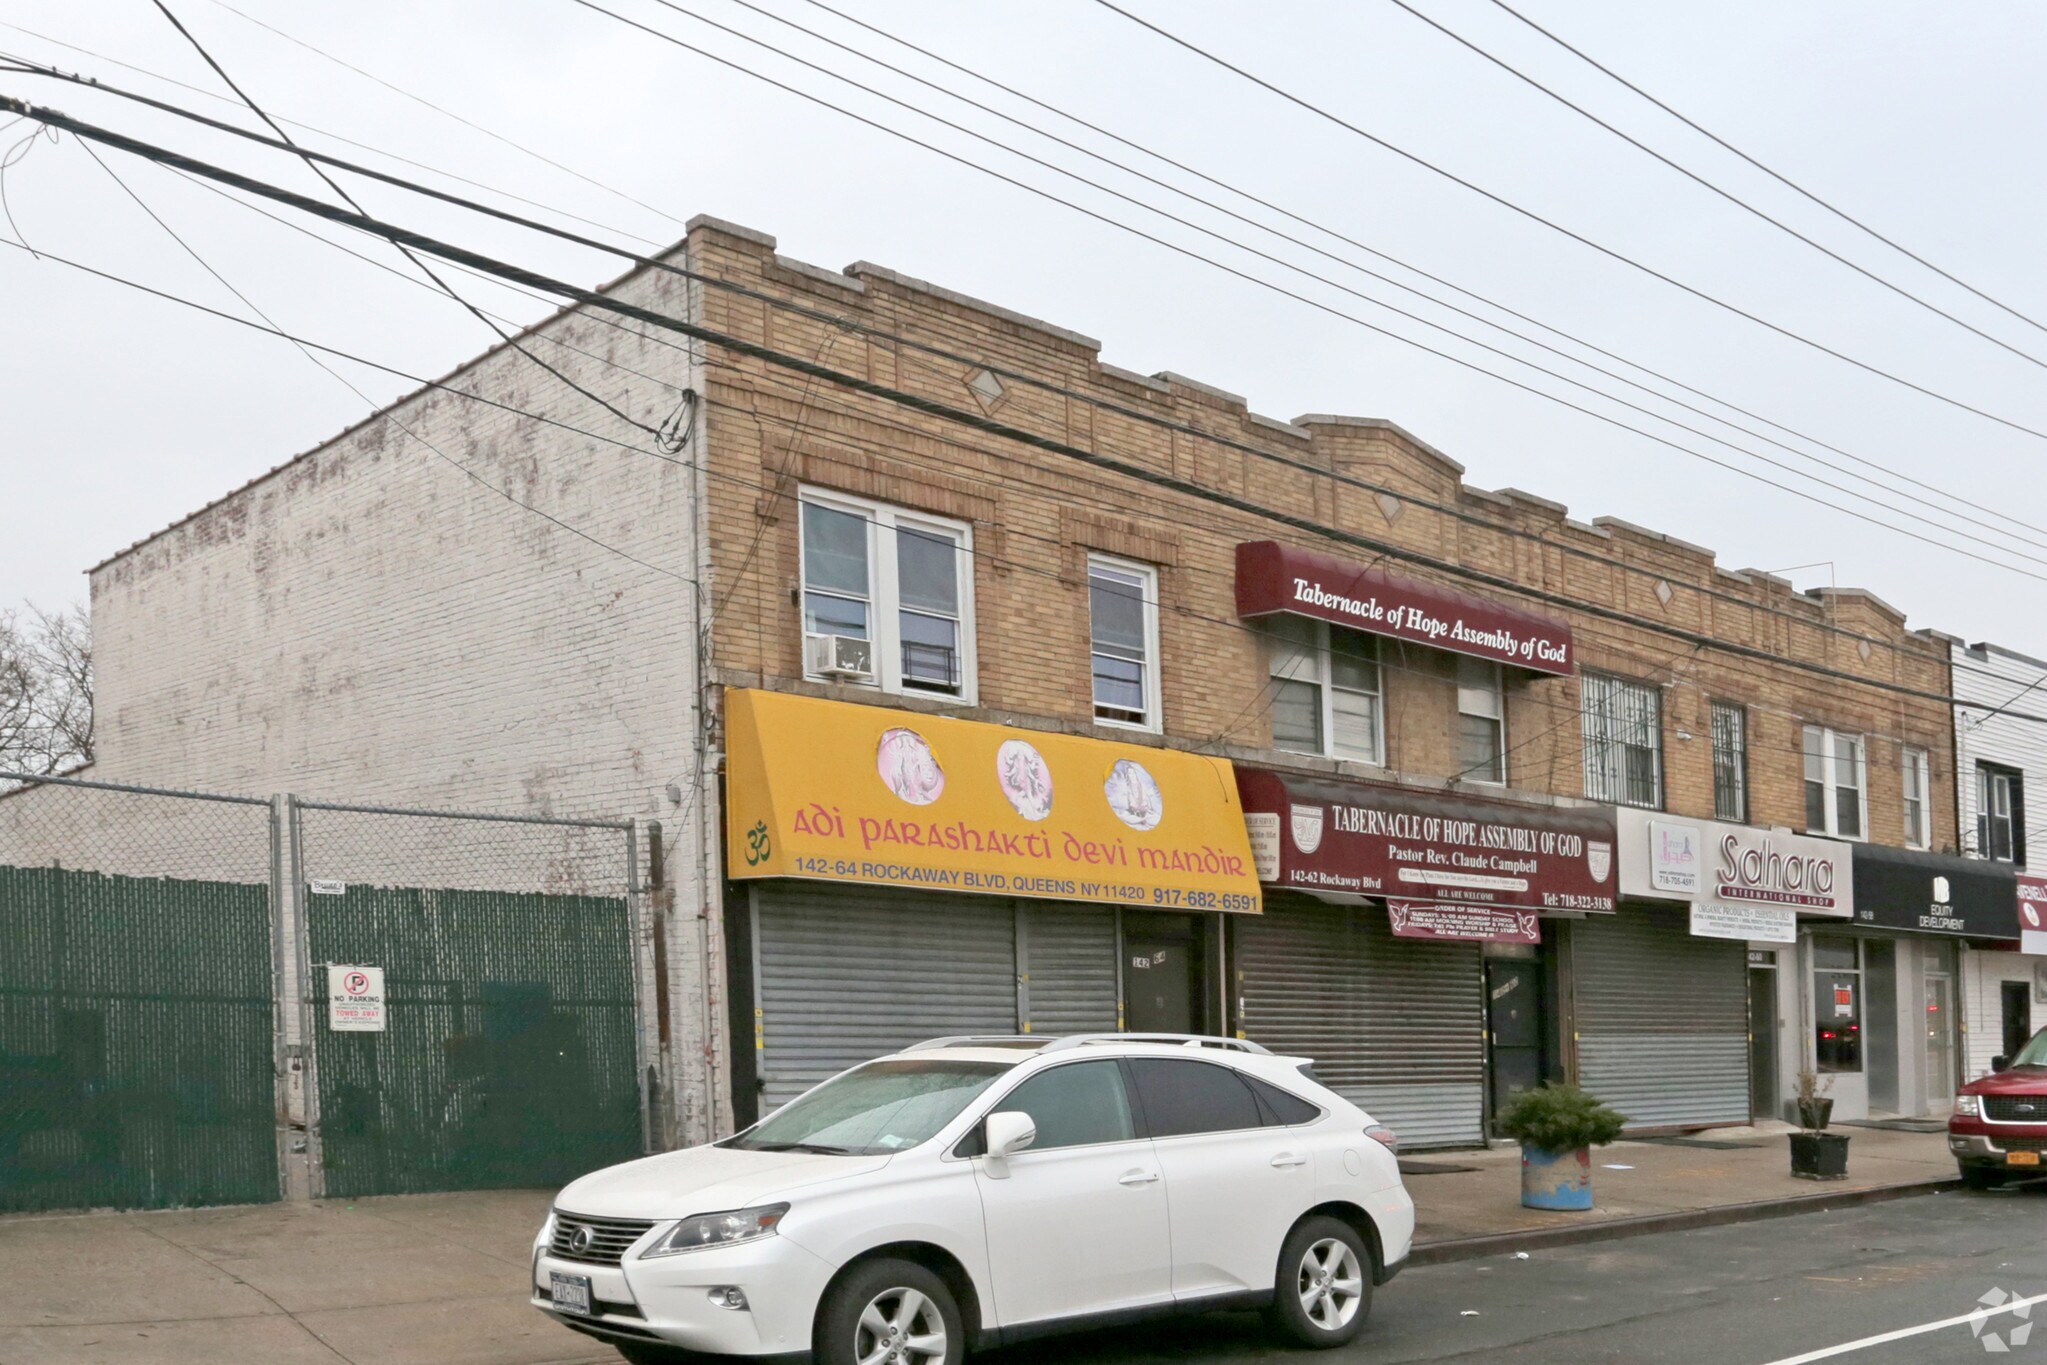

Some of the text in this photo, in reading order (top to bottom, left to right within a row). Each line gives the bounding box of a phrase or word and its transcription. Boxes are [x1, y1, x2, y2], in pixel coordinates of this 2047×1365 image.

[1294, 578, 1566, 663] Tabernacle of Hope Assembly of God
[1332, 805, 1421, 840] TABERNACLE
[1423, 817, 1441, 841] OF
[1443, 819, 1477, 846] HOPE
[1479, 824, 1539, 853] ASSEMBLY
[1540, 831, 1556, 855] OF
[1558, 833, 1582, 857] GOD
[1389, 844, 1537, 875] Pastor Rev. Claude Campbell
[1717, 833, 1834, 895] Sahara
[795, 857, 1258, 911] 142-64 ROCKAWAY BLVD, QUEENS NY 11420 917-682-6591
[1291, 870, 1381, 890] 142-62 Rockaway Blvd
[1437, 890, 1494, 901] ALL ARE WELCOME
[1542, 892, 1612, 910] Tel: 718-322-3138
[1727, 887, 1829, 906] INTERNATIONAL SHOP
[1467, 907, 1491, 915] SERVICE
[1698, 904, 1722, 914] ORGANIC
[1723, 906, 1750, 916] PRODUCTS
[1931, 904, 1953, 916] EQUITY
[1919, 915, 1965, 930] DEVELOPMENT
[1134, 957, 1149, 968] 142
